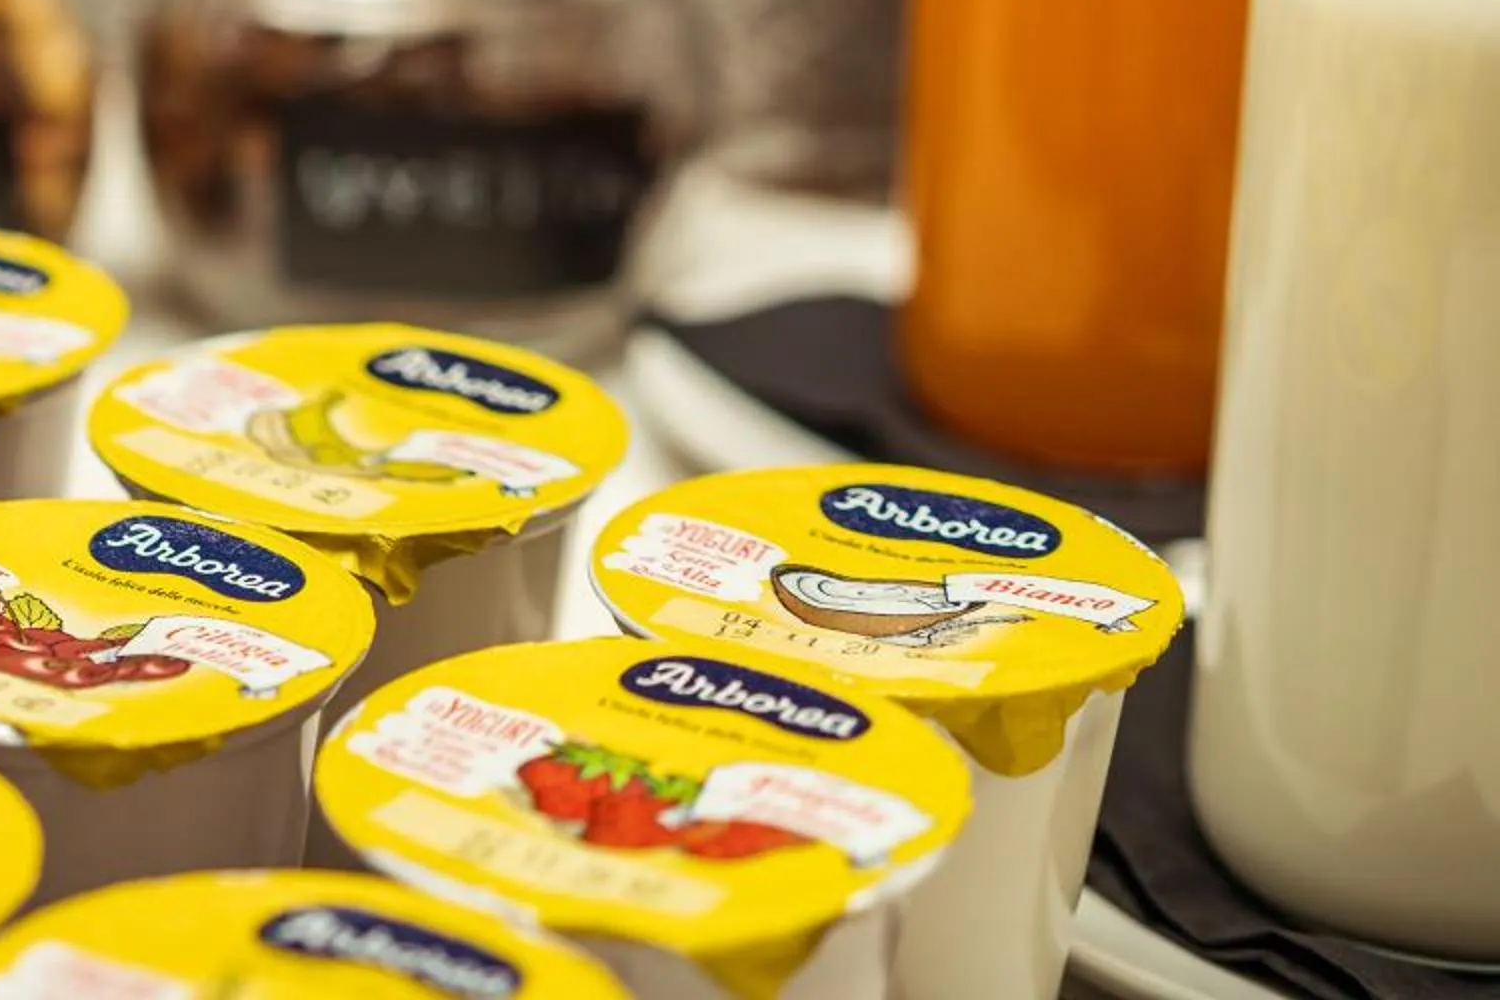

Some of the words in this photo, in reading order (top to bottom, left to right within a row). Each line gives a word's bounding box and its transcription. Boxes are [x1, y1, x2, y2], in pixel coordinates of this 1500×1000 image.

[675, 520, 774, 562] YOGURT
[834, 487, 1050, 550] Arborea
[107, 523, 291, 598] Arborea
[975, 577, 1115, 611] Bianco
[636, 661, 859, 737] Arborea
